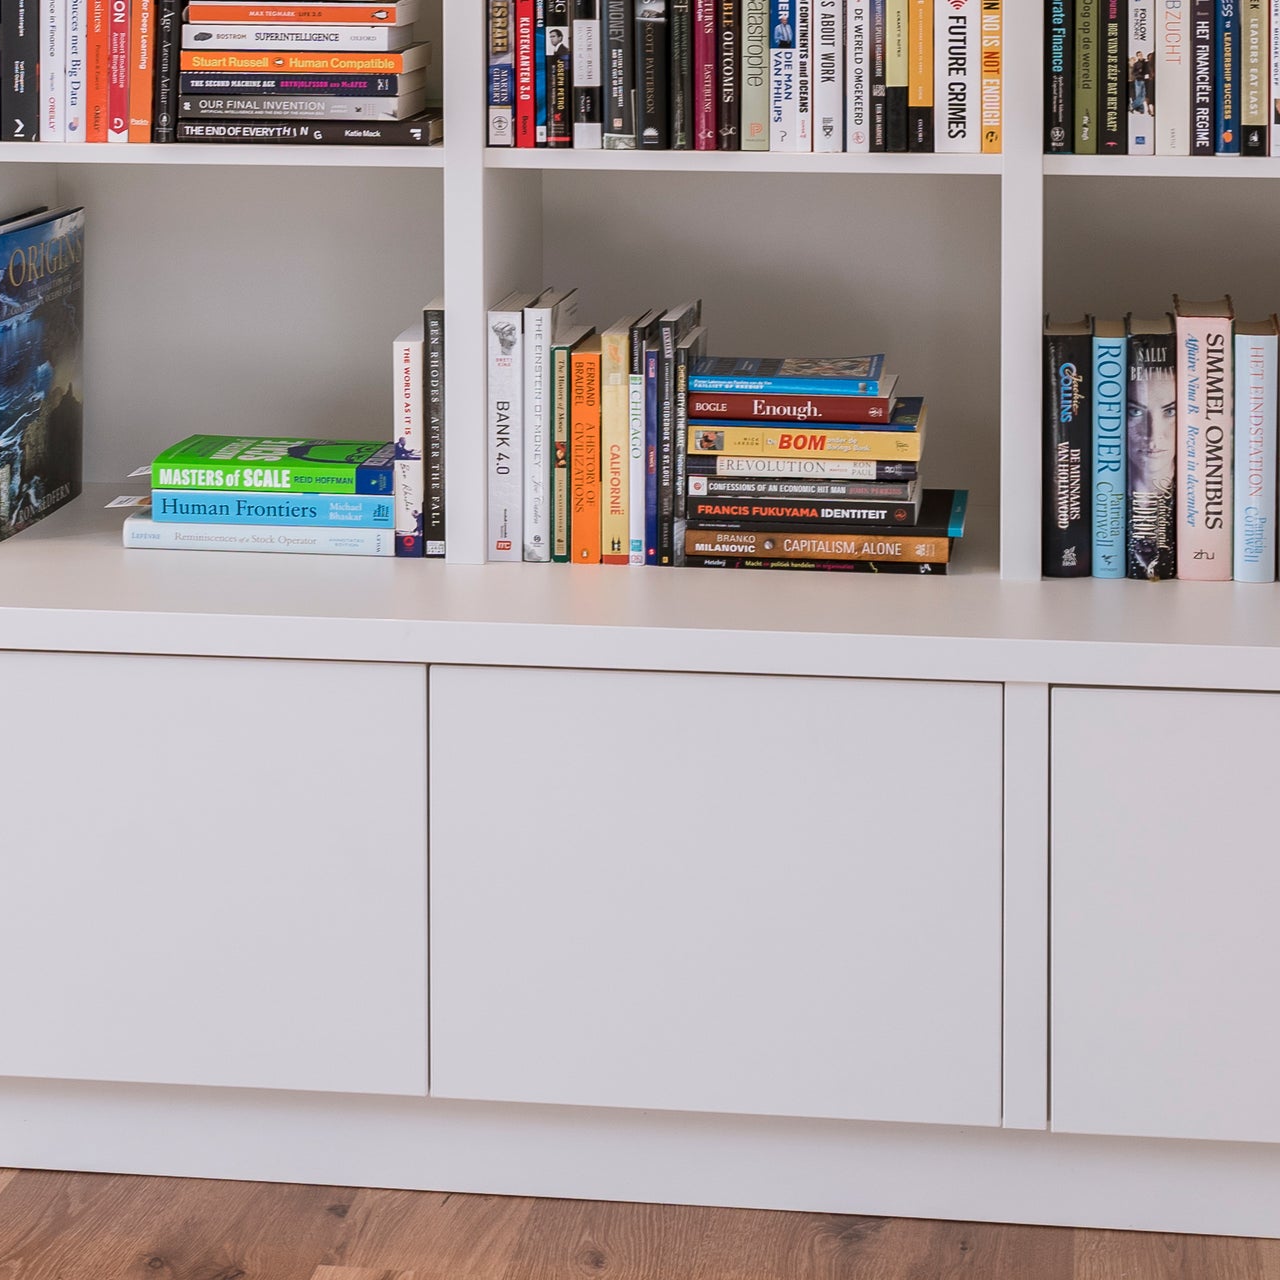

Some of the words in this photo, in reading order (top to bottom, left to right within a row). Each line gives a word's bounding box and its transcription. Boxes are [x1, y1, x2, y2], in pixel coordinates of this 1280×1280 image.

[140, 12, 148, 33] Deep
[608, 1, 624, 42] MONEY
[821, 13, 835, 47] ABOUT
[984, 15, 999, 31] NO
[1196, 21, 1208, 39] HET
[139, 35, 148, 69] Learning
[255, 33, 339, 41] SUPERINTELLIGENCE
[520, 17, 530, 83] KLOTEKLANTEN
[948, 16, 966, 76] FUTURE
[984, 35, 999, 46] IS
[1052, 28, 1065, 72] Finance
[192, 57, 225, 67] Stuart
[228, 57, 268, 67] Russell
[289, 58, 327, 68] Human
[330, 58, 394, 69] Compatible
[723, 31, 734, 103] OUTCOMES
[774, 52, 782, 77] VAN
[784, 52, 792, 70] DIE
[821, 53, 835, 83] WORK
[984, 51, 999, 75] NOT
[1196, 45, 1210, 103] FINANCIËLE
[520, 86, 530, 100] 3.0
[774, 79, 783, 122] PHILIPS
[784, 73, 792, 100] MAN
[199, 100, 223, 109] OUR
[226, 100, 260, 109] FINAL
[263, 101, 324, 110] INVENTION
[948, 82, 966, 139] CRIMES
[984, 79, 1000, 126] ENOUGH
[1196, 108, 1208, 147] REGIME
[575, 362, 584, 405] BRAUDEL
[586, 362, 594, 406] FERNAND
[1206, 333, 1224, 420] SIMMEL
[695, 402, 727, 411] BOGLE
[752, 400, 823, 420] Enough.
[1097, 345, 1122, 473] ROOFDIER
[431, 417, 439, 457] AFTER
[496, 402, 510, 448] BANK
[586, 423, 594, 431] A
[631, 390, 641, 459] CHICAGO
[779, 434, 826, 450] BOM
[497, 452, 509, 475] 4.0
[575, 422, 584, 513] CIVILIZATIONS
[586, 435, 594, 486] HISTORY
[160, 469, 223, 486] MASTERS
[225, 472, 240, 486] of
[243, 469, 290, 488] SCALE
[316, 476, 353, 485] HOFFMAN
[431, 464, 439, 489] THE
[610, 444, 624, 515] CALIFORNIË
[1206, 426, 1223, 529] OMNIBUS
[162, 498, 229, 516] Human
[236, 500, 317, 518] Frontiers
[432, 496, 440, 527] FALL
[587, 490, 595, 506] OF
[697, 505, 749, 516] FRANCIS
[752, 507, 818, 518] FUKUYAMA
[821, 509, 887, 519] IDENTITEIT
[1096, 481, 1113, 547] Cornwell
[1111, 493, 1124, 536] Patricia
[784, 540, 858, 556] CAPITALISM,
[861, 542, 902, 556] ALONE
